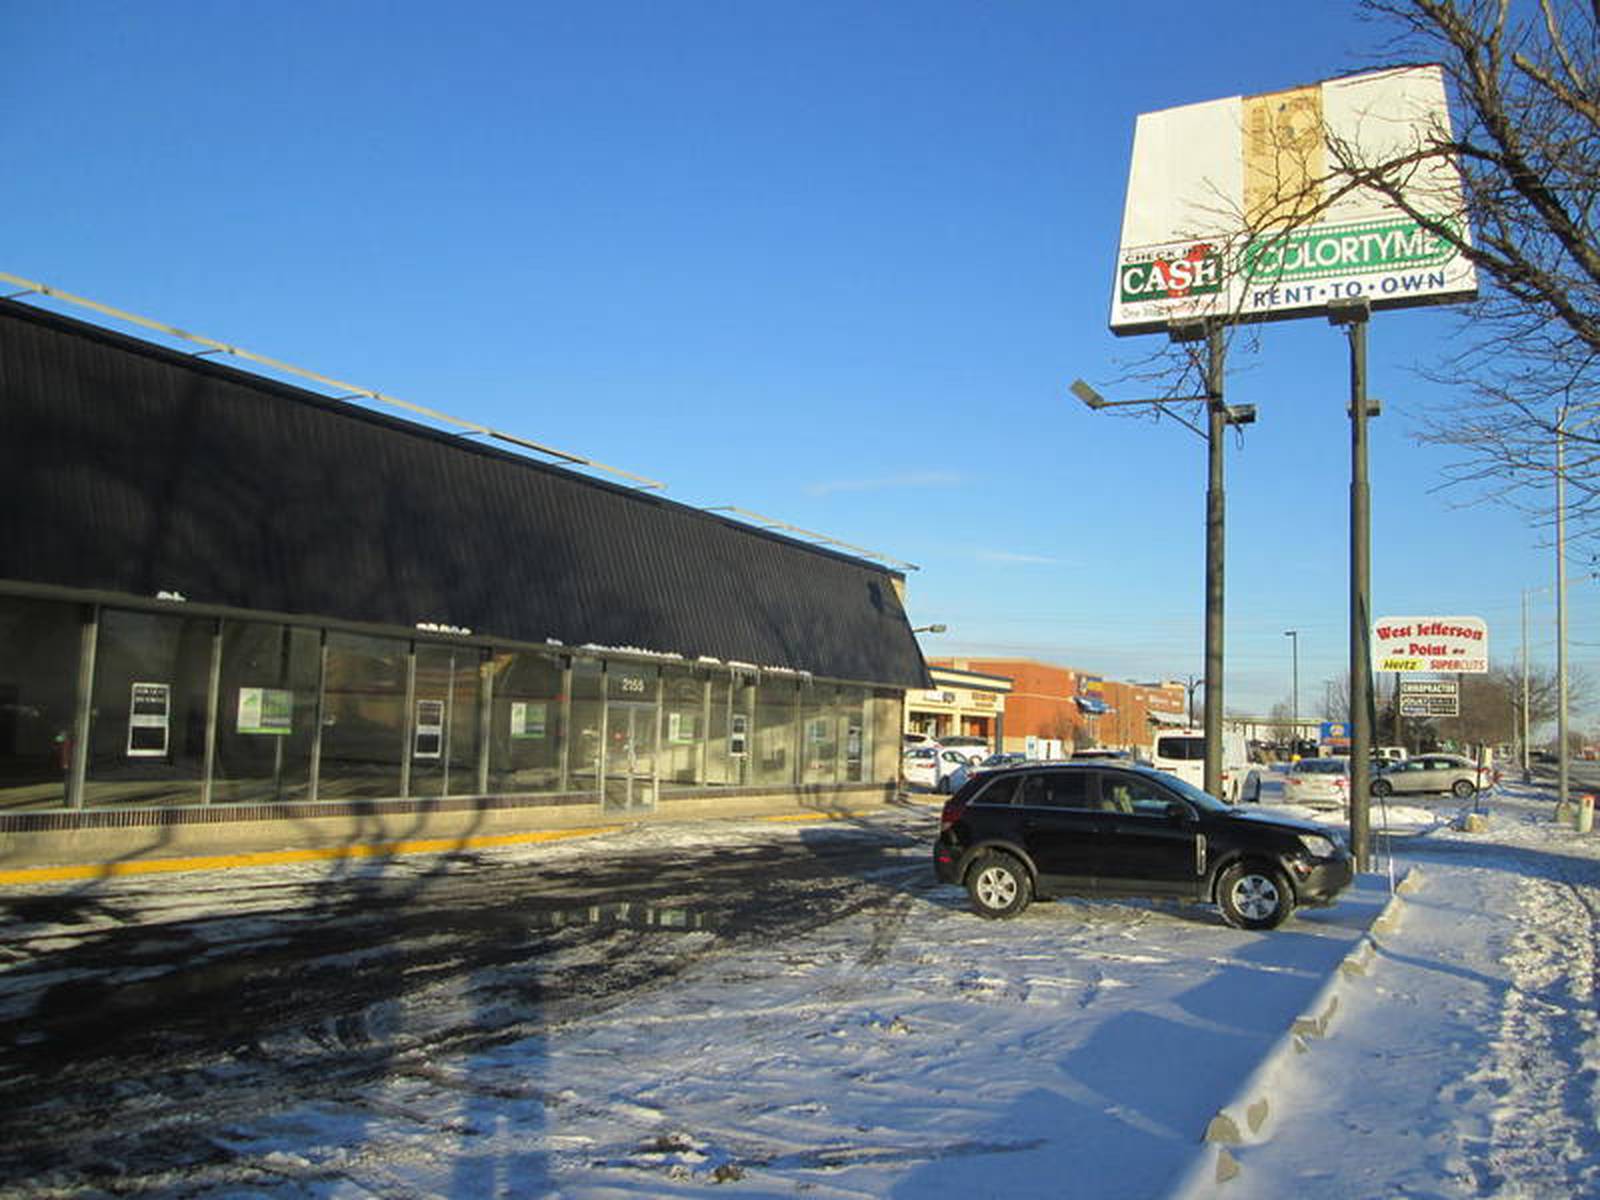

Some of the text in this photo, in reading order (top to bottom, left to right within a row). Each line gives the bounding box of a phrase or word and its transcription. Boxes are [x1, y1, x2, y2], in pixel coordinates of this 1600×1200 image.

[1122, 259, 1218, 295] CASH
[1377, 623, 1483, 640] West Jefferson
[1408, 643, 1447, 656] Point
[1383, 659, 1486, 670] Hertz SUPERCUTS
